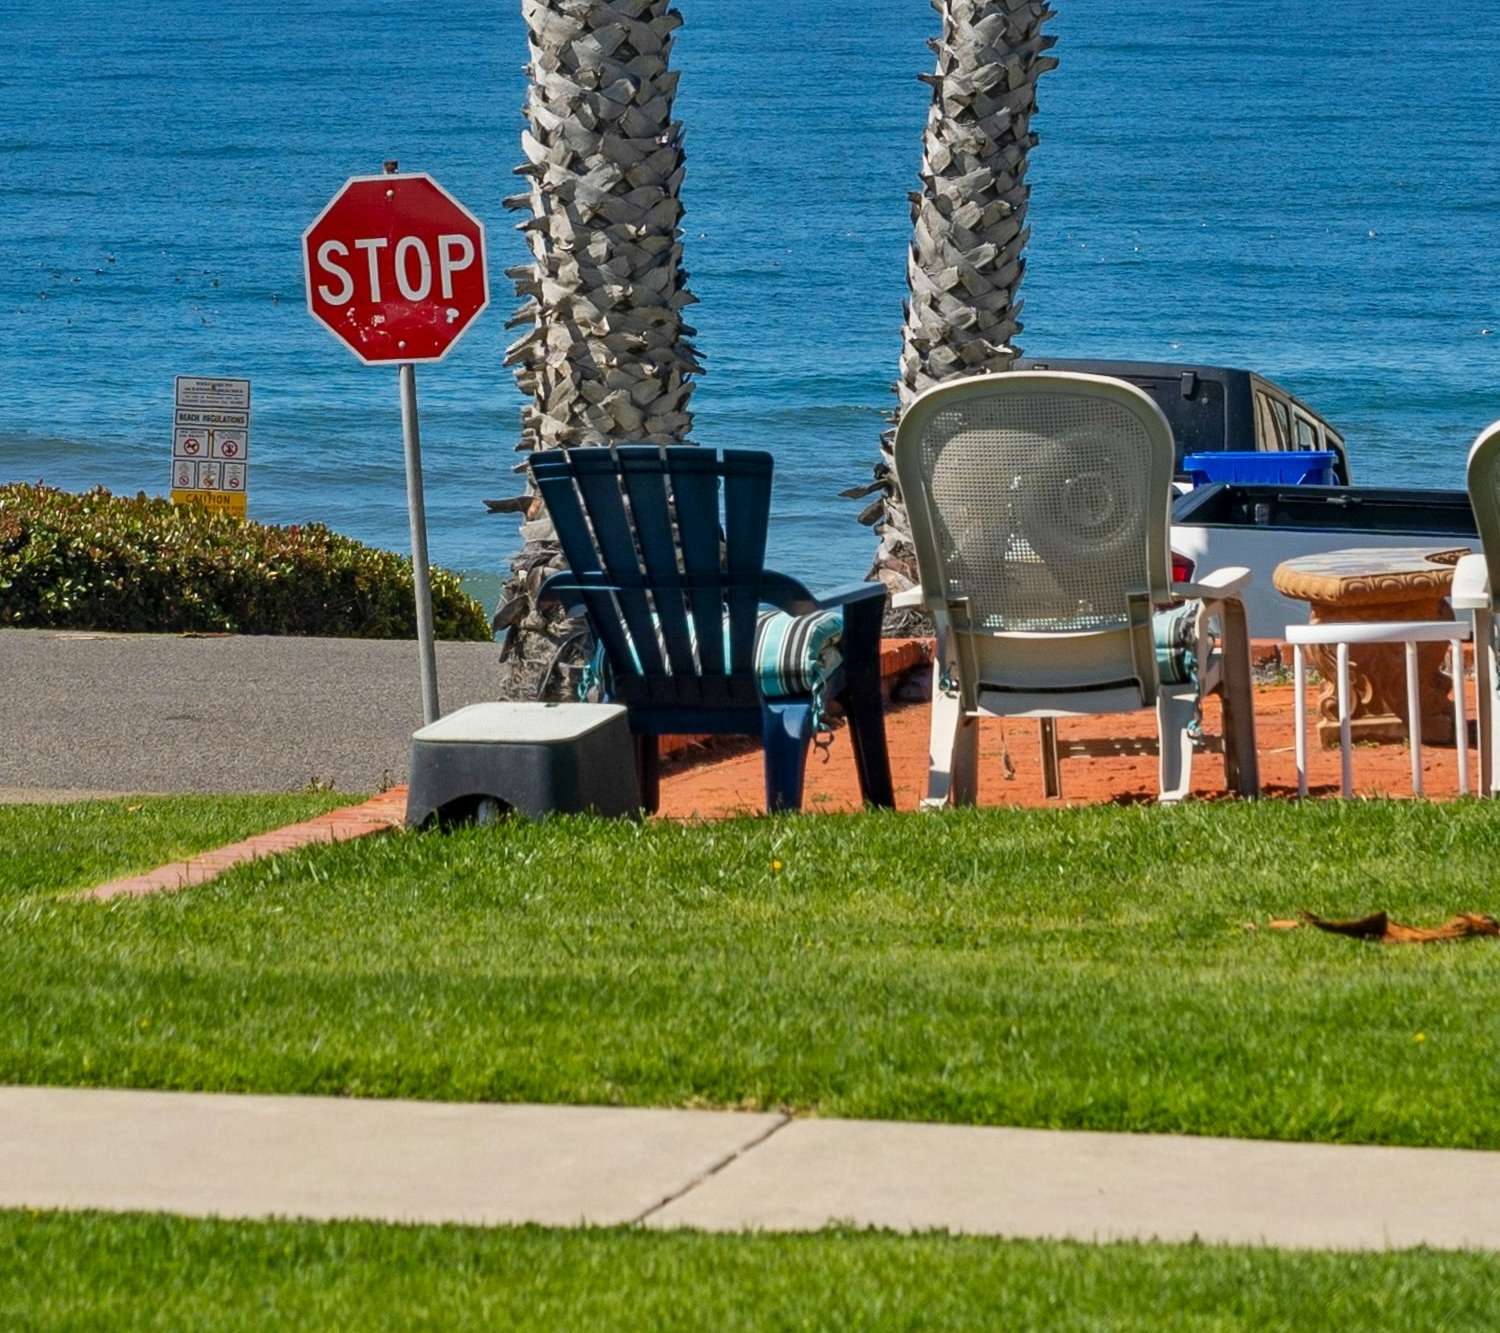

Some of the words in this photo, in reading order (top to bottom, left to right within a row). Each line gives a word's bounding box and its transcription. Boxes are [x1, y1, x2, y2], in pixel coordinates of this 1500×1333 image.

[317, 234, 475, 306] STOP
[179, 413, 200, 422] BEACH
[202, 415, 245, 424] REGULATIONS
[186, 493, 231, 504] CAUTION
